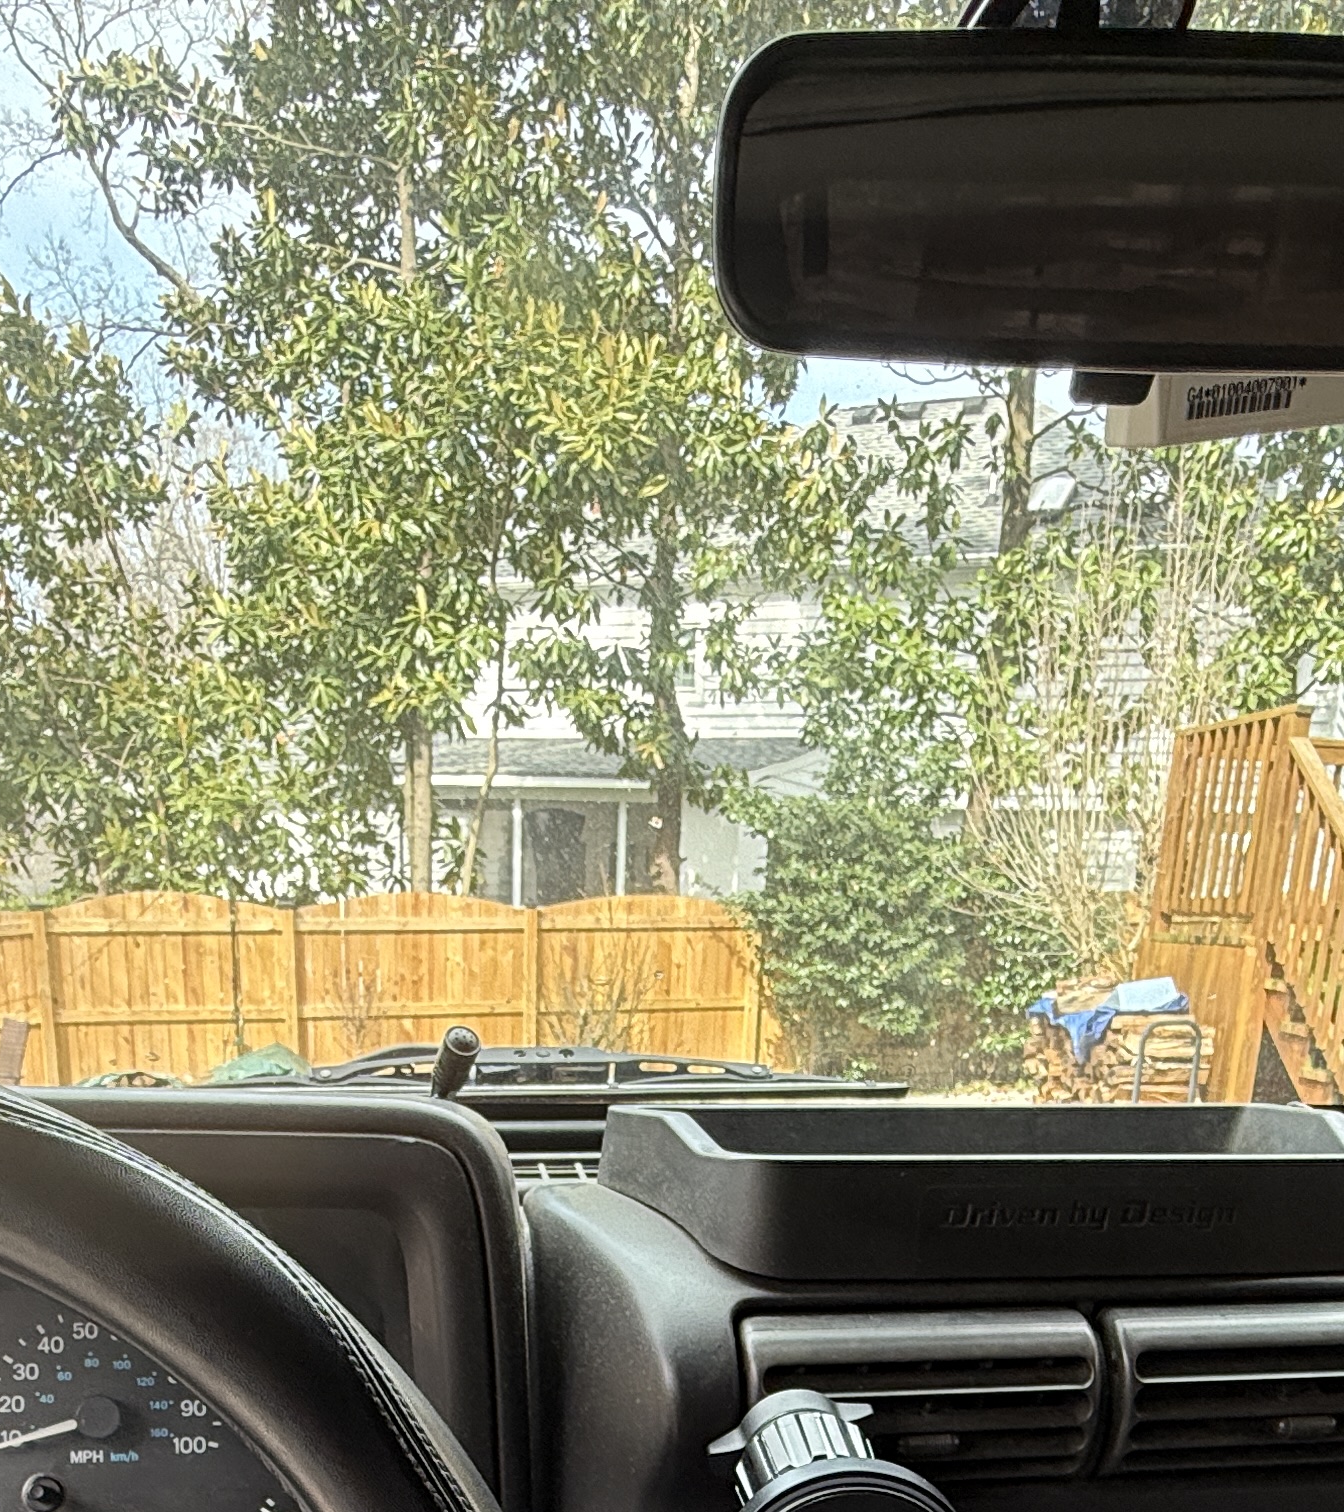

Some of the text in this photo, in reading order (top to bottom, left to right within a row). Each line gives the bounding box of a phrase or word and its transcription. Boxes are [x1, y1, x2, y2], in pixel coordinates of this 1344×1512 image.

[940, 1199, 1237, 1232] Driven by Design
[72, 1322, 98, 1340] 50
[38, 1336, 64, 1354] 40
[84, 1358, 99, 1368] 80
[113, 1360, 131, 1370] 100
[12, 1363, 39, 1381] 30
[57, 1371, 72, 1381] 60
[136, 1376, 155, 1386] 120
[0, 1395, 24, 1413] 20
[39, 1394, 54, 1404] 40
[149, 1401, 168, 1411] 140
[181, 1400, 206, 1418] 90
[173, 1437, 206, 1454] 100
[70, 1451, 139, 1464] MPH km/h
